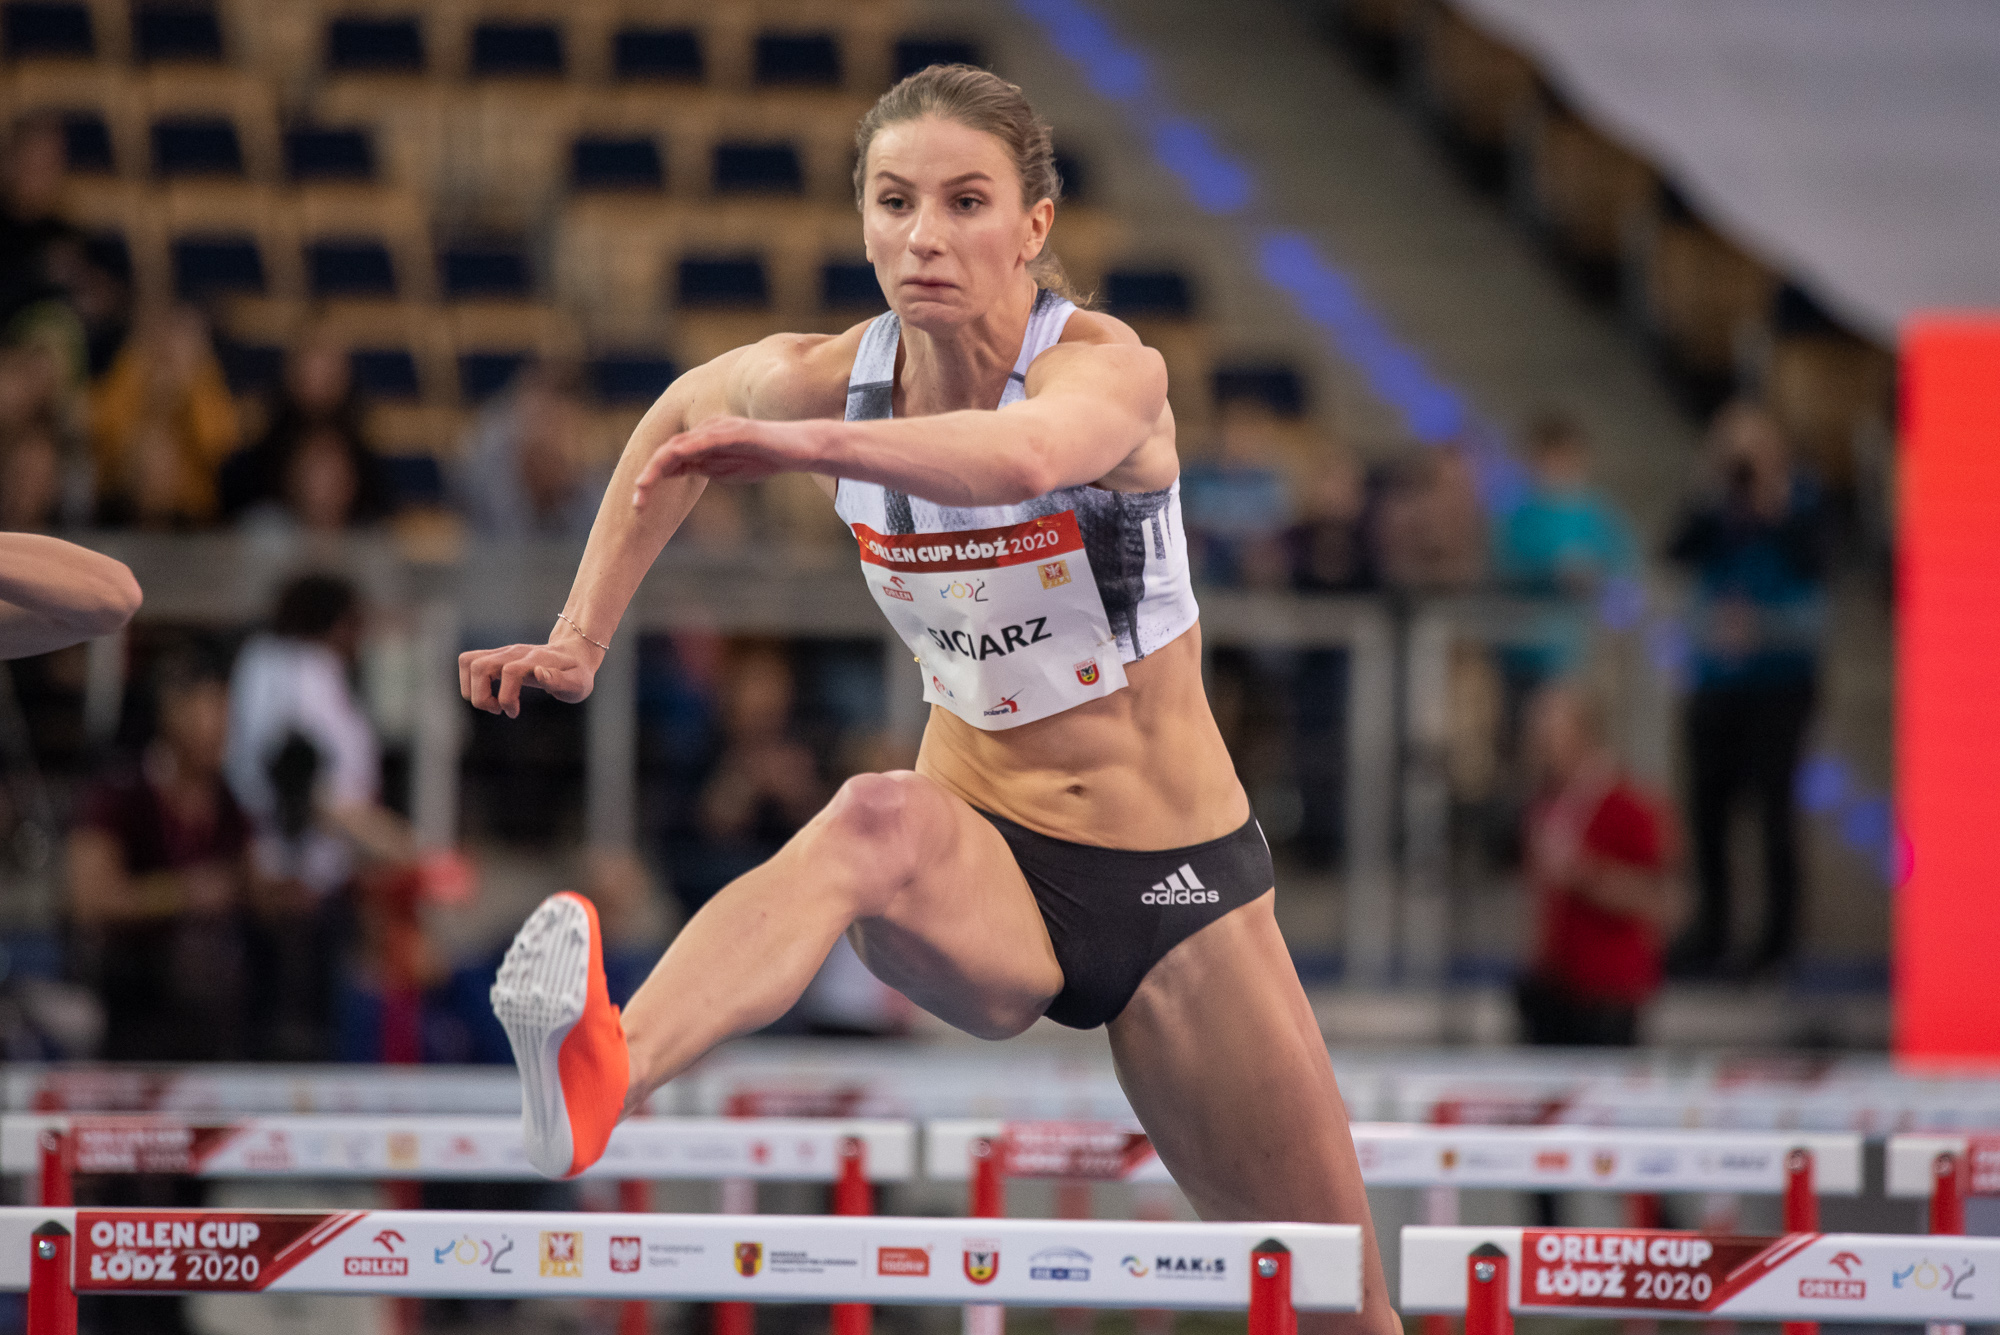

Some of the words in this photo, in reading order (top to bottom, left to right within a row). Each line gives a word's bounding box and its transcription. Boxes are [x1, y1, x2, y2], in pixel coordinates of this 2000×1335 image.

[869, 541, 917, 563] ORLEN
[917, 545, 953, 562] CUP
[955, 536, 1009, 561] ŁÓDŹ
[1010, 530, 1059, 554] 2020
[884, 588, 912, 600] ORLEN
[927, 616, 1052, 661] SICIARZ
[1141, 889, 1220, 905] adidas
[90, 1221, 195, 1248] ORLEN
[199, 1222, 260, 1249] CUP
[90, 1250, 176, 1281] ŁÓDŹ
[186, 1254, 259, 1281] 2020
[347, 1259, 405, 1273] ORLEN
[1536, 1235, 1646, 1266] ORLEN
[1648, 1239, 1713, 1268] CUP
[1536, 1262, 1627, 1298] ŁÓDŹ
[1634, 1270, 1713, 1302] 2020
[1802, 1281, 1862, 1297] ORLEN
